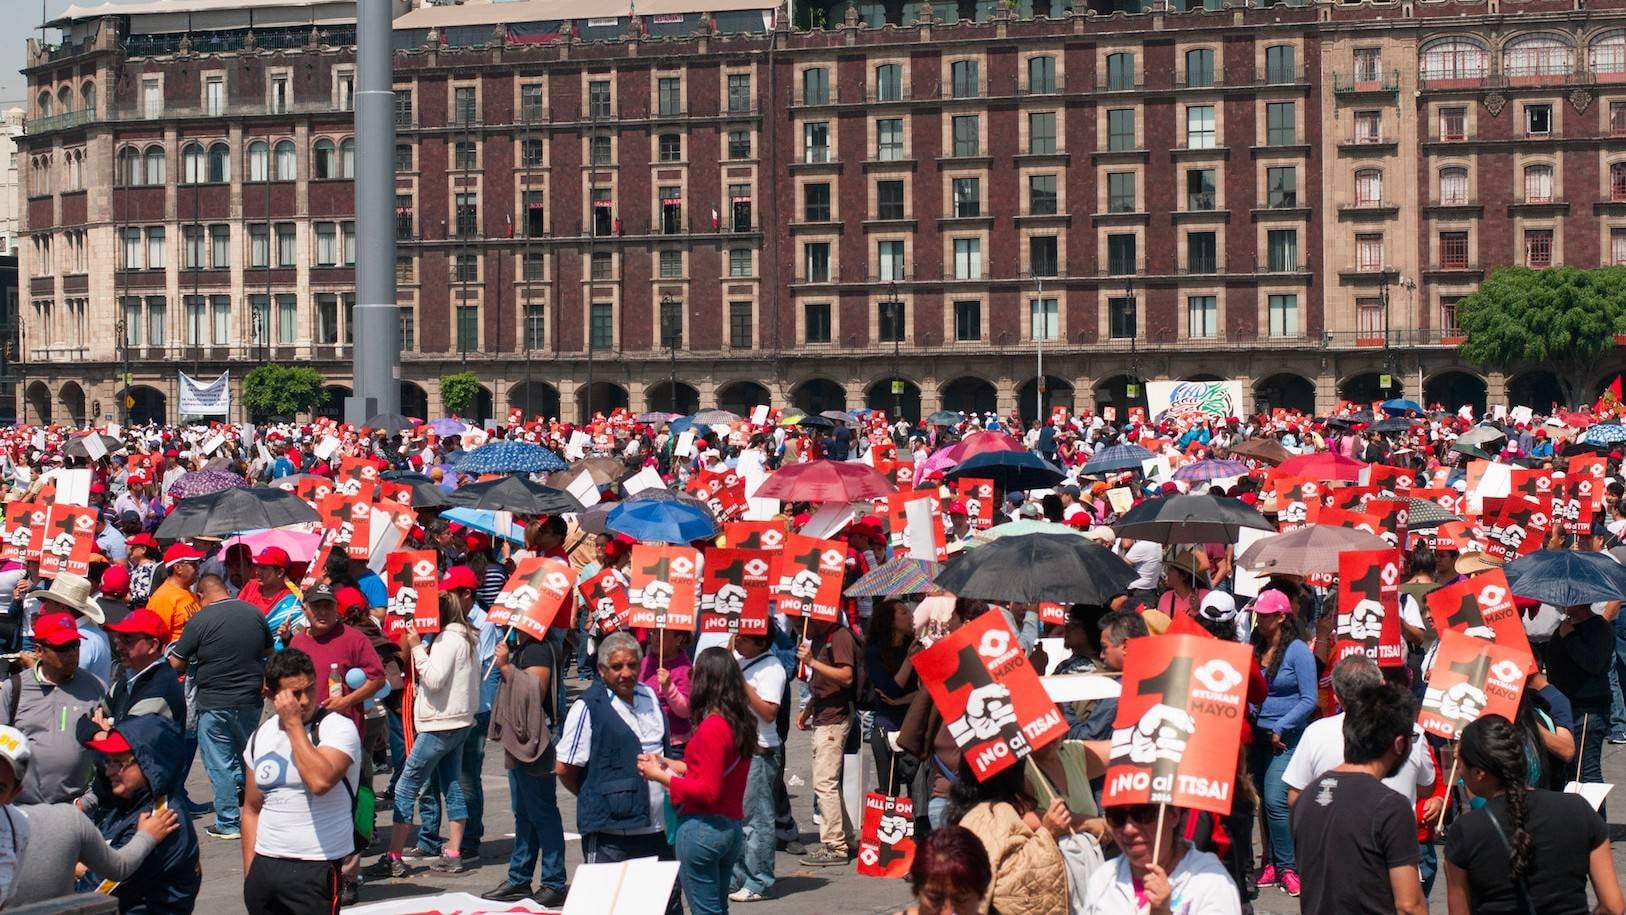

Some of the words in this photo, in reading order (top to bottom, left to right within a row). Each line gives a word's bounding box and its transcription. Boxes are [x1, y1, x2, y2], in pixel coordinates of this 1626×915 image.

[1505, 550, 1515, 558] al
[780, 599, 801, 610] ¡NO
[801, 603, 812, 612] al
[1043, 606, 1064, 618] ¡NO
[1482, 601, 1512, 615] STUNAM
[415, 617, 438, 627] TTP!
[633, 612, 655, 623] ¡NO
[656, 613, 666, 622] al
[668, 613, 693, 624] TTP!
[704, 617, 728, 630] ¡NO
[728, 618, 739, 628] al
[740, 618, 765, 629] TTP!
[1484, 608, 1514, 625] MAYO
[1366, 646, 1378, 658] al
[1379, 644, 1401, 658] TISA!
[993, 656, 1025, 682] MAYO
[1191, 689, 1239, 704] STUNAM
[1485, 685, 1517, 701] MAYO
[1190, 701, 1238, 719] MAYO
[1422, 719, 1454, 734] ¡NO
[976, 741, 1009, 773] ¡NO
[1009, 731, 1027, 750] al
[1023, 709, 1061, 740] TISA!
[260, 765, 271, 779] S
[1110, 771, 1150, 797] ¡NO
[1152, 773, 1174, 791] al
[1177, 773, 1230, 801] TISA!
